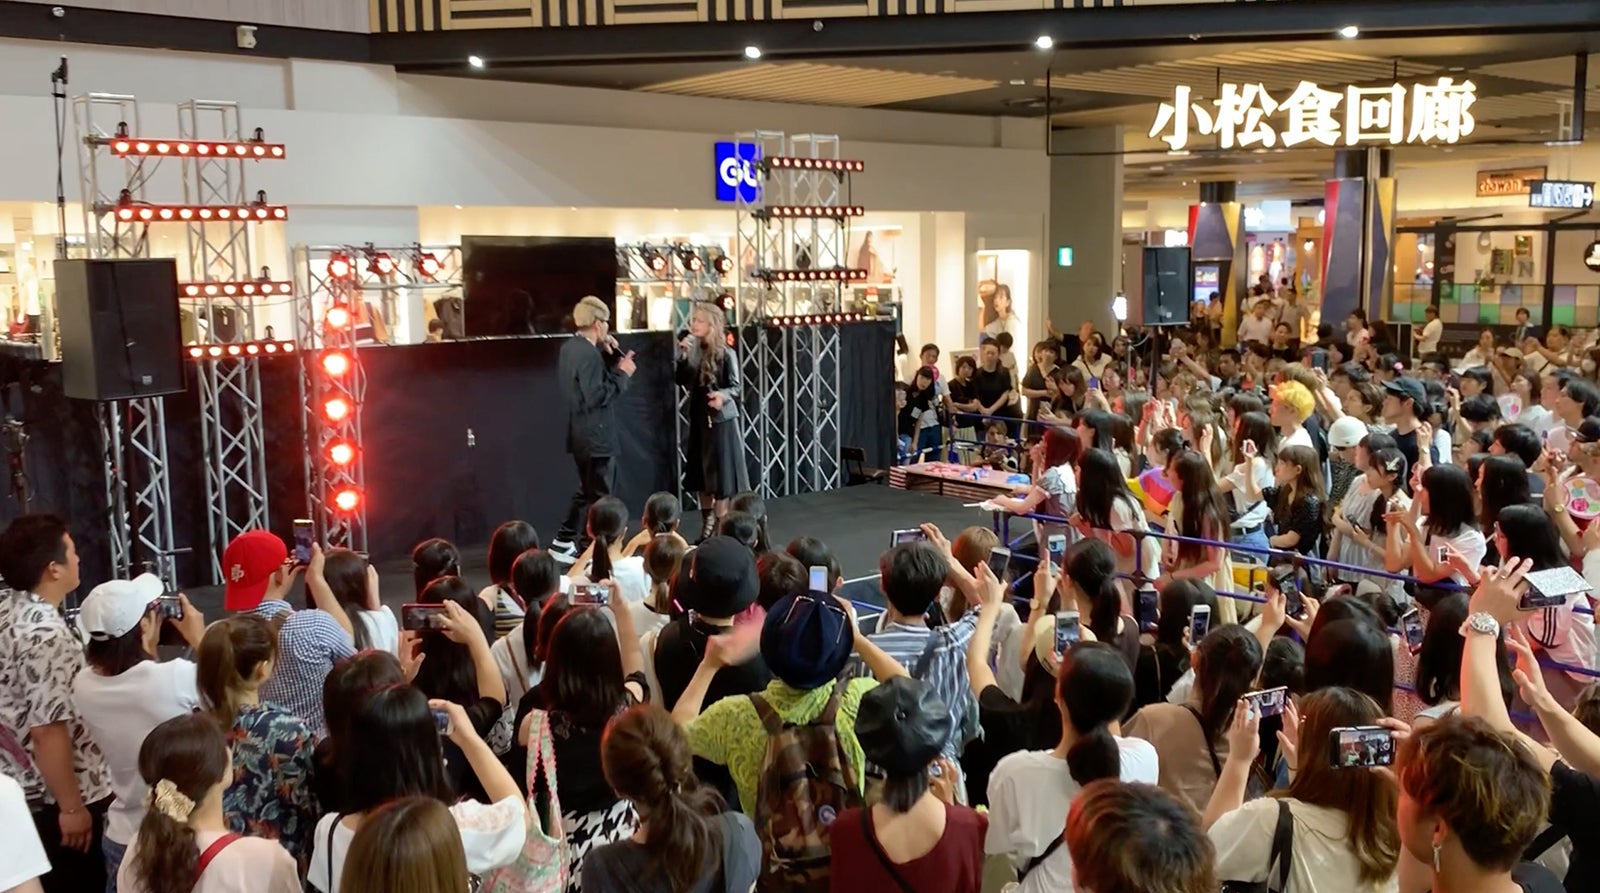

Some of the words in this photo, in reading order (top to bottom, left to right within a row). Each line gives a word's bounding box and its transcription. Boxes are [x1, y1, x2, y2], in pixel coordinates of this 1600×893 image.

[1148, 77, 1477, 150] 小松食回廊
[720, 157, 762, 187] GU
[1479, 178, 1522, 193] chawan
